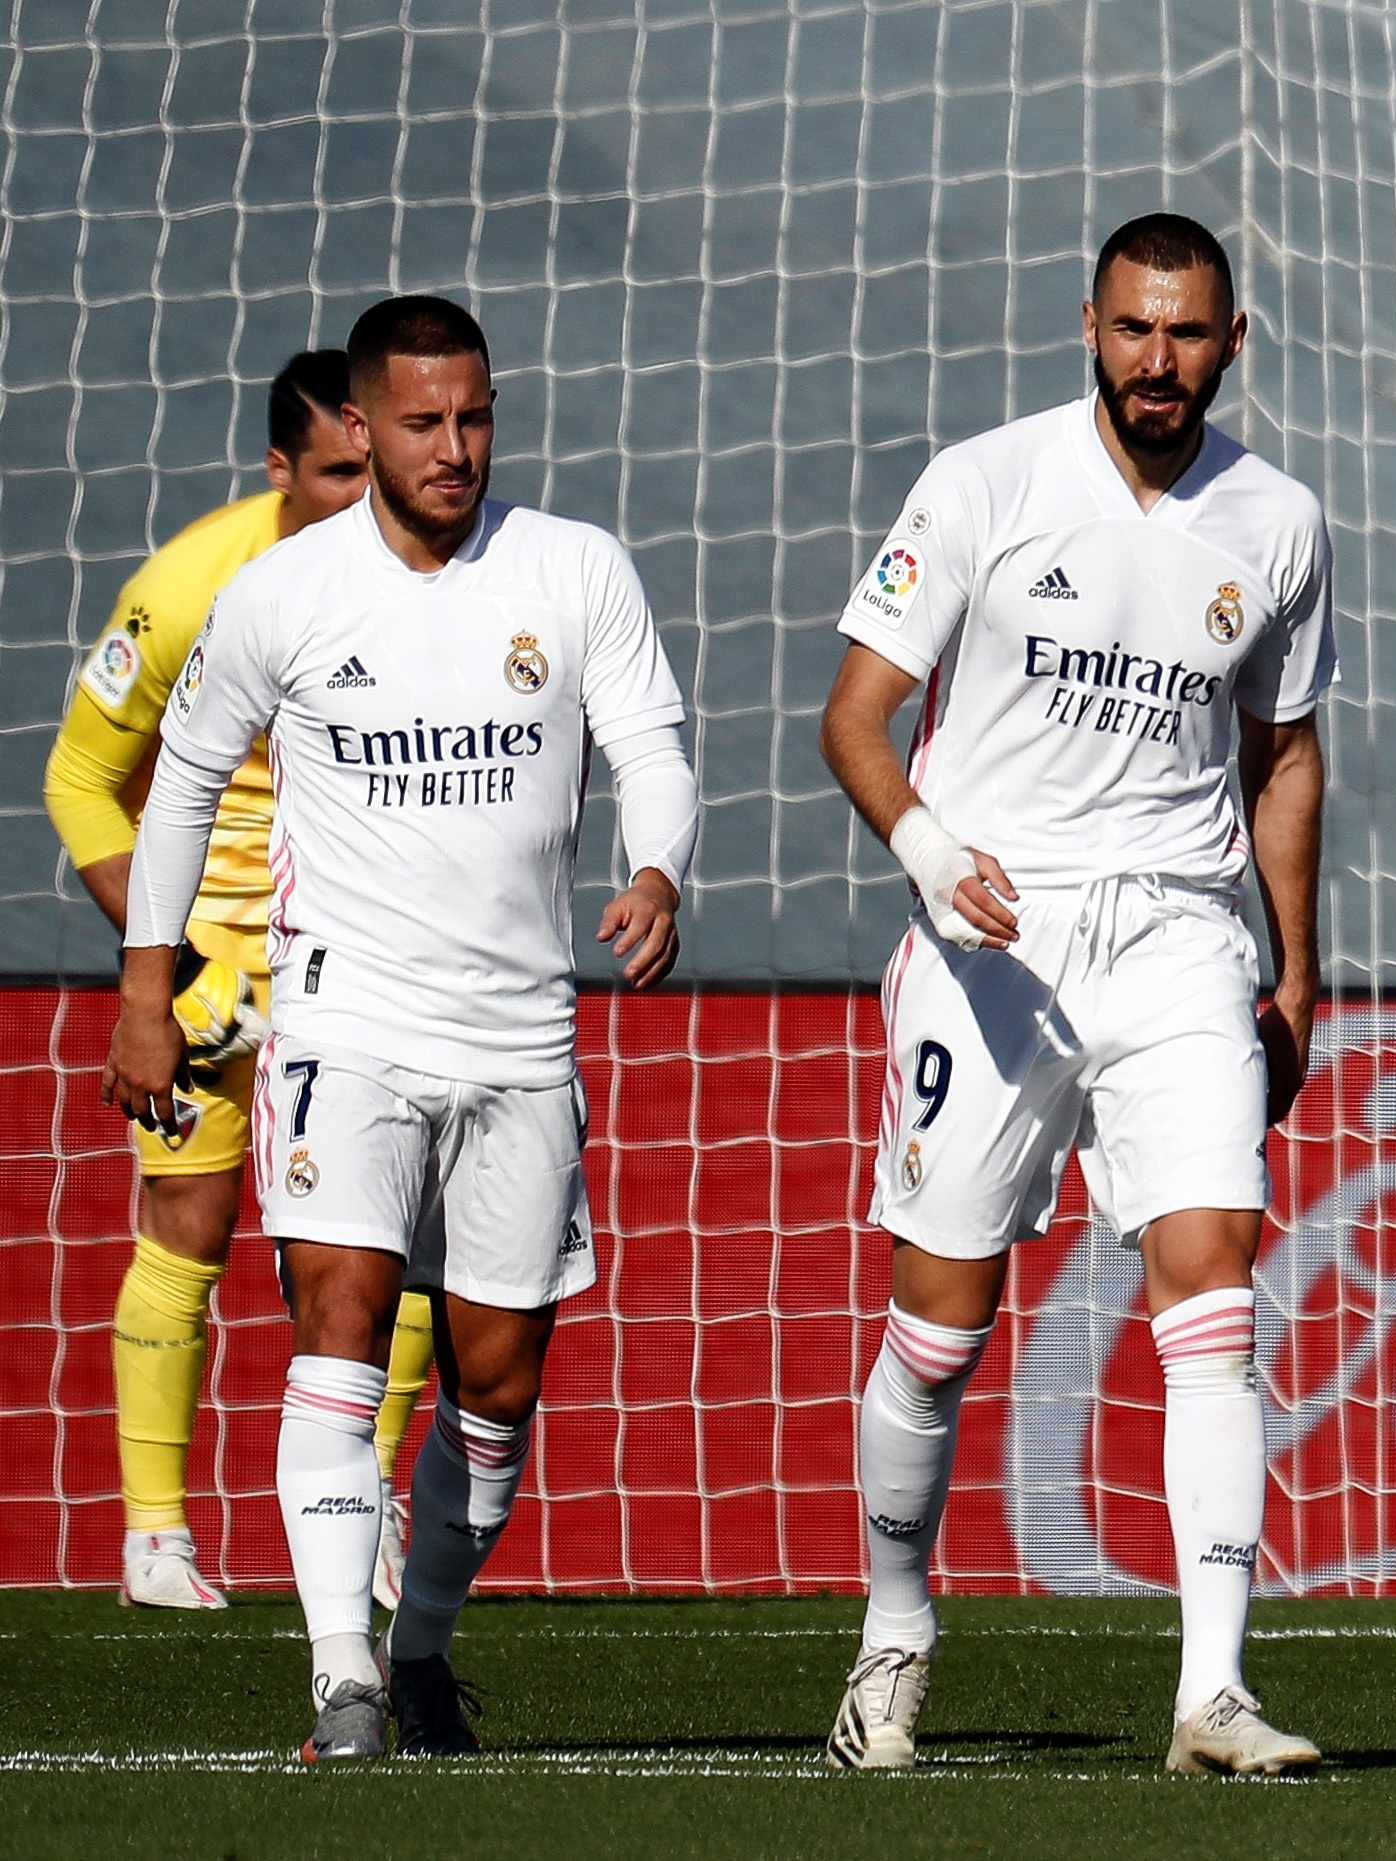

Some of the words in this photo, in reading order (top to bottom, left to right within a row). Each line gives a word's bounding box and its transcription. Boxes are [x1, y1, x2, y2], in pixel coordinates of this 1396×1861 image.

[862, 589, 903, 618] LaLiga
[1028, 586, 1079, 600] adidas
[326, 676, 377, 689] adidas
[1024, 635, 1223, 706] Emirates
[1044, 687, 1095, 728] FLY
[1094, 697, 1183, 746] BETTER
[326, 717, 544, 766] Emirates
[367, 774, 410, 807] FLY
[421, 766, 515, 807] BETTER
[281, 1060, 321, 1143] 7
[912, 1039, 953, 1134] 9
[301, 1506, 376, 1515] MADRID
[317, 1497, 364, 1507] REAL
[1211, 1543, 1250, 1558] REAL
